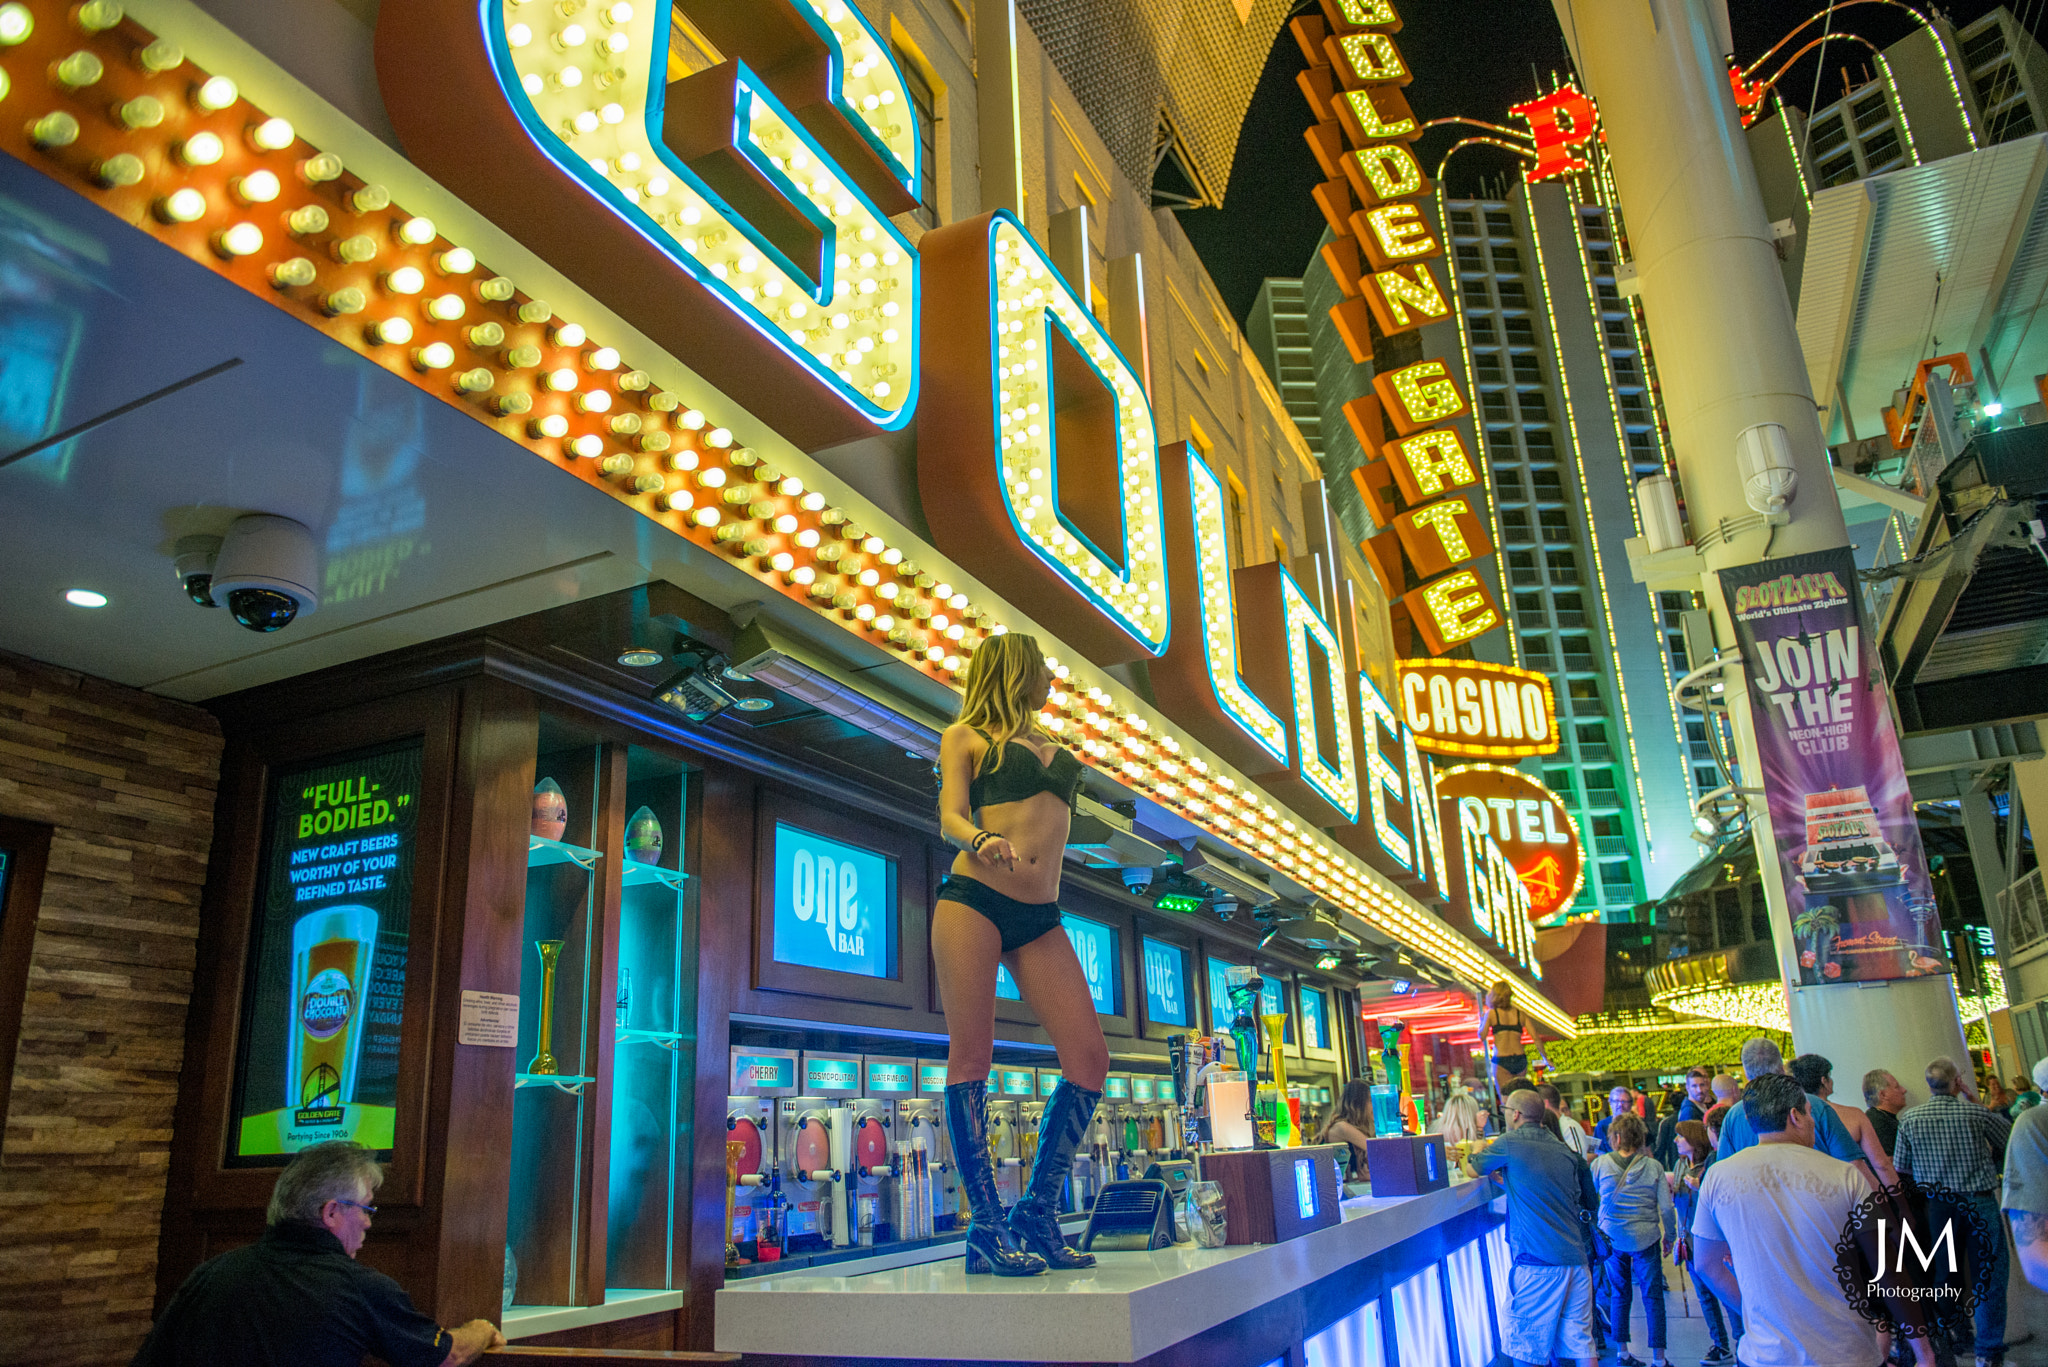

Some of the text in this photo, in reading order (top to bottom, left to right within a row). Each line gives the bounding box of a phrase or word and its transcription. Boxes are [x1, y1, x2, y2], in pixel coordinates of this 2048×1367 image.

[1390, 361, 1498, 644] GATE
[1737, 597, 1848, 622] World's Ultimate Zipline
[1755, 626, 1860, 692] JOIN
[1402, 671, 1549, 741] CASINO
[1770, 683, 1854, 728] THE
[1788, 723, 1852, 741] NEON-HIGH
[1797, 736, 1849, 756] CLUB
[292, 833, 398, 865] NEW CRAFT BEERS
[290, 854, 397, 884] WORTHY OF YOUR
[296, 875, 387, 901] REFINED TASTE.
[838, 932, 865, 956] BAR
[310, 994, 346, 1010] DOUBLE
[304, 1005, 349, 1021] CHOCOLATE
[749, 1065, 779, 1081] CHERRY
[808, 1071, 856, 1082] COSMOPOLITAN
[871, 1073, 909, 1083] WATERMELON
[922, 1076, 944, 1085] MOSCOW
[297, 1111, 323, 1119] GOLDEN
[288, 1129, 348, 1142] Partying Since 1906
